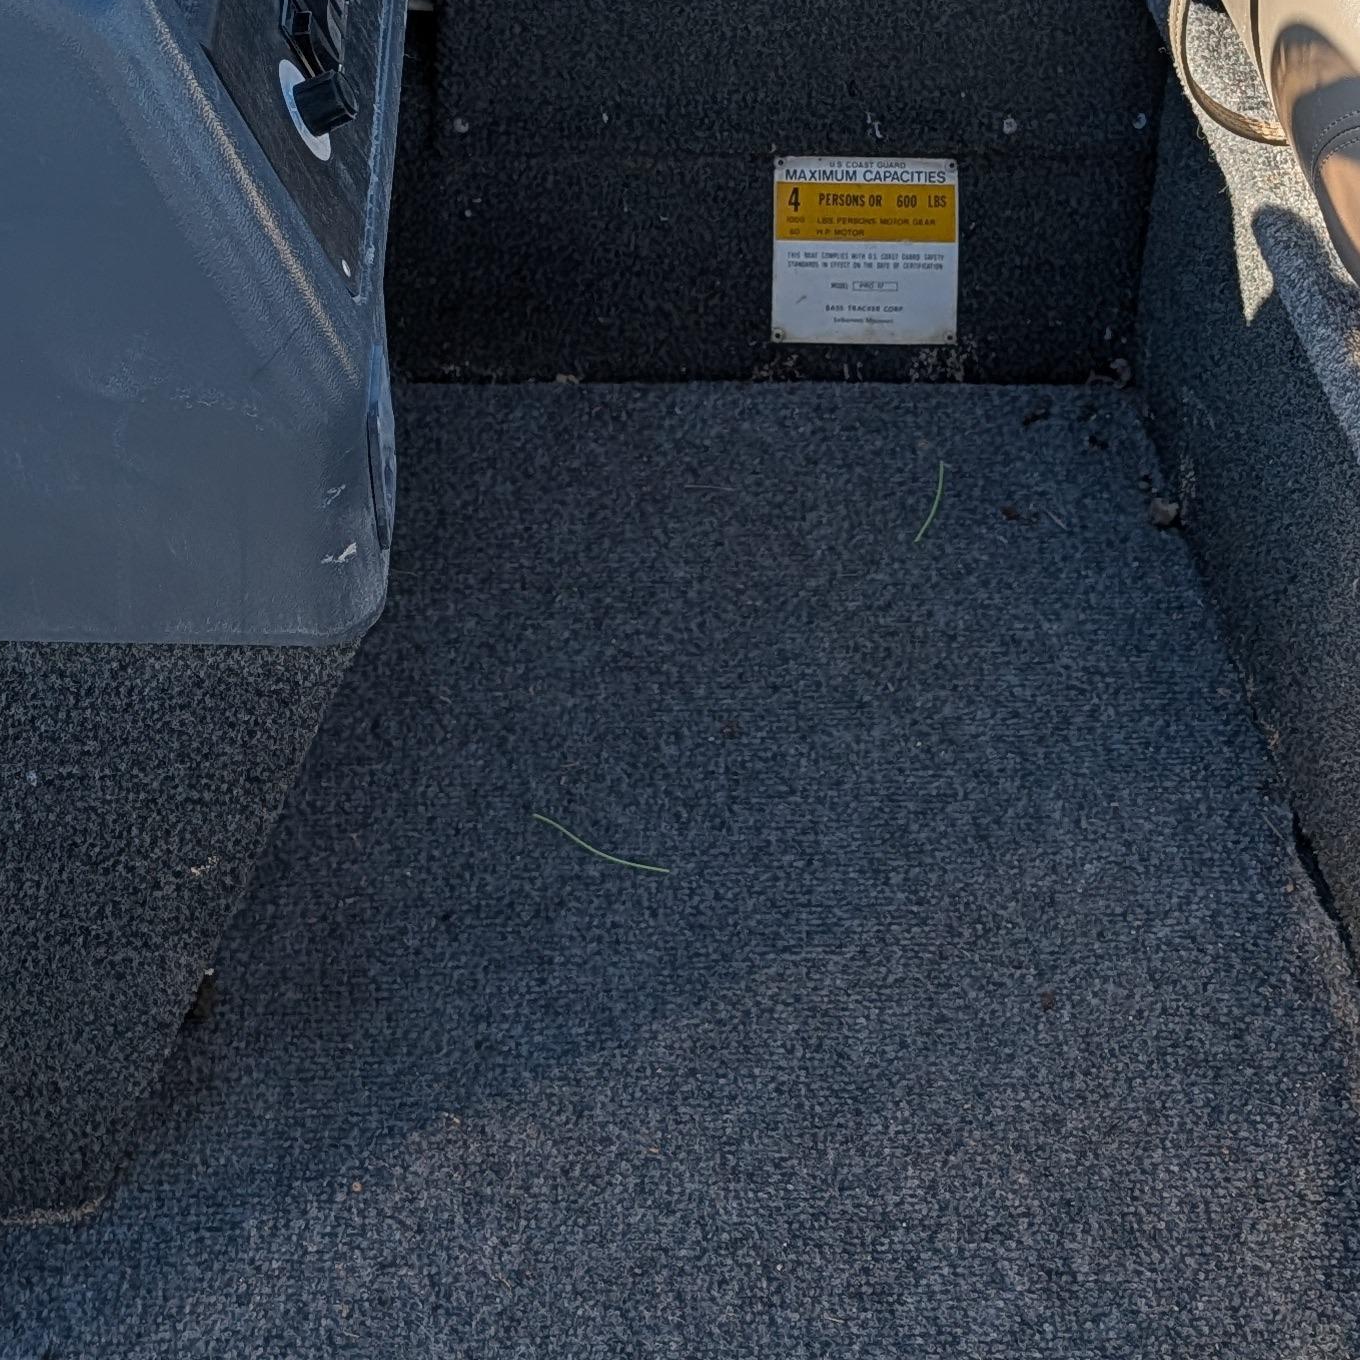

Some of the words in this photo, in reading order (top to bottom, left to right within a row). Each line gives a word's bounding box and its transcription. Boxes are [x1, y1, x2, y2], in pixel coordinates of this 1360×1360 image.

[846, 161, 874, 169] COAST
[785, 169, 857, 182] MAXIMUM
[863, 170, 946, 183] CAPACITIES
[788, 186, 801, 213] 4
[818, 193, 865, 207] PERSONS
[869, 195, 882, 207] OR
[897, 195, 917, 208] 600
[928, 196, 947, 208] LBS
[822, 252, 848, 260] COMPLIES
